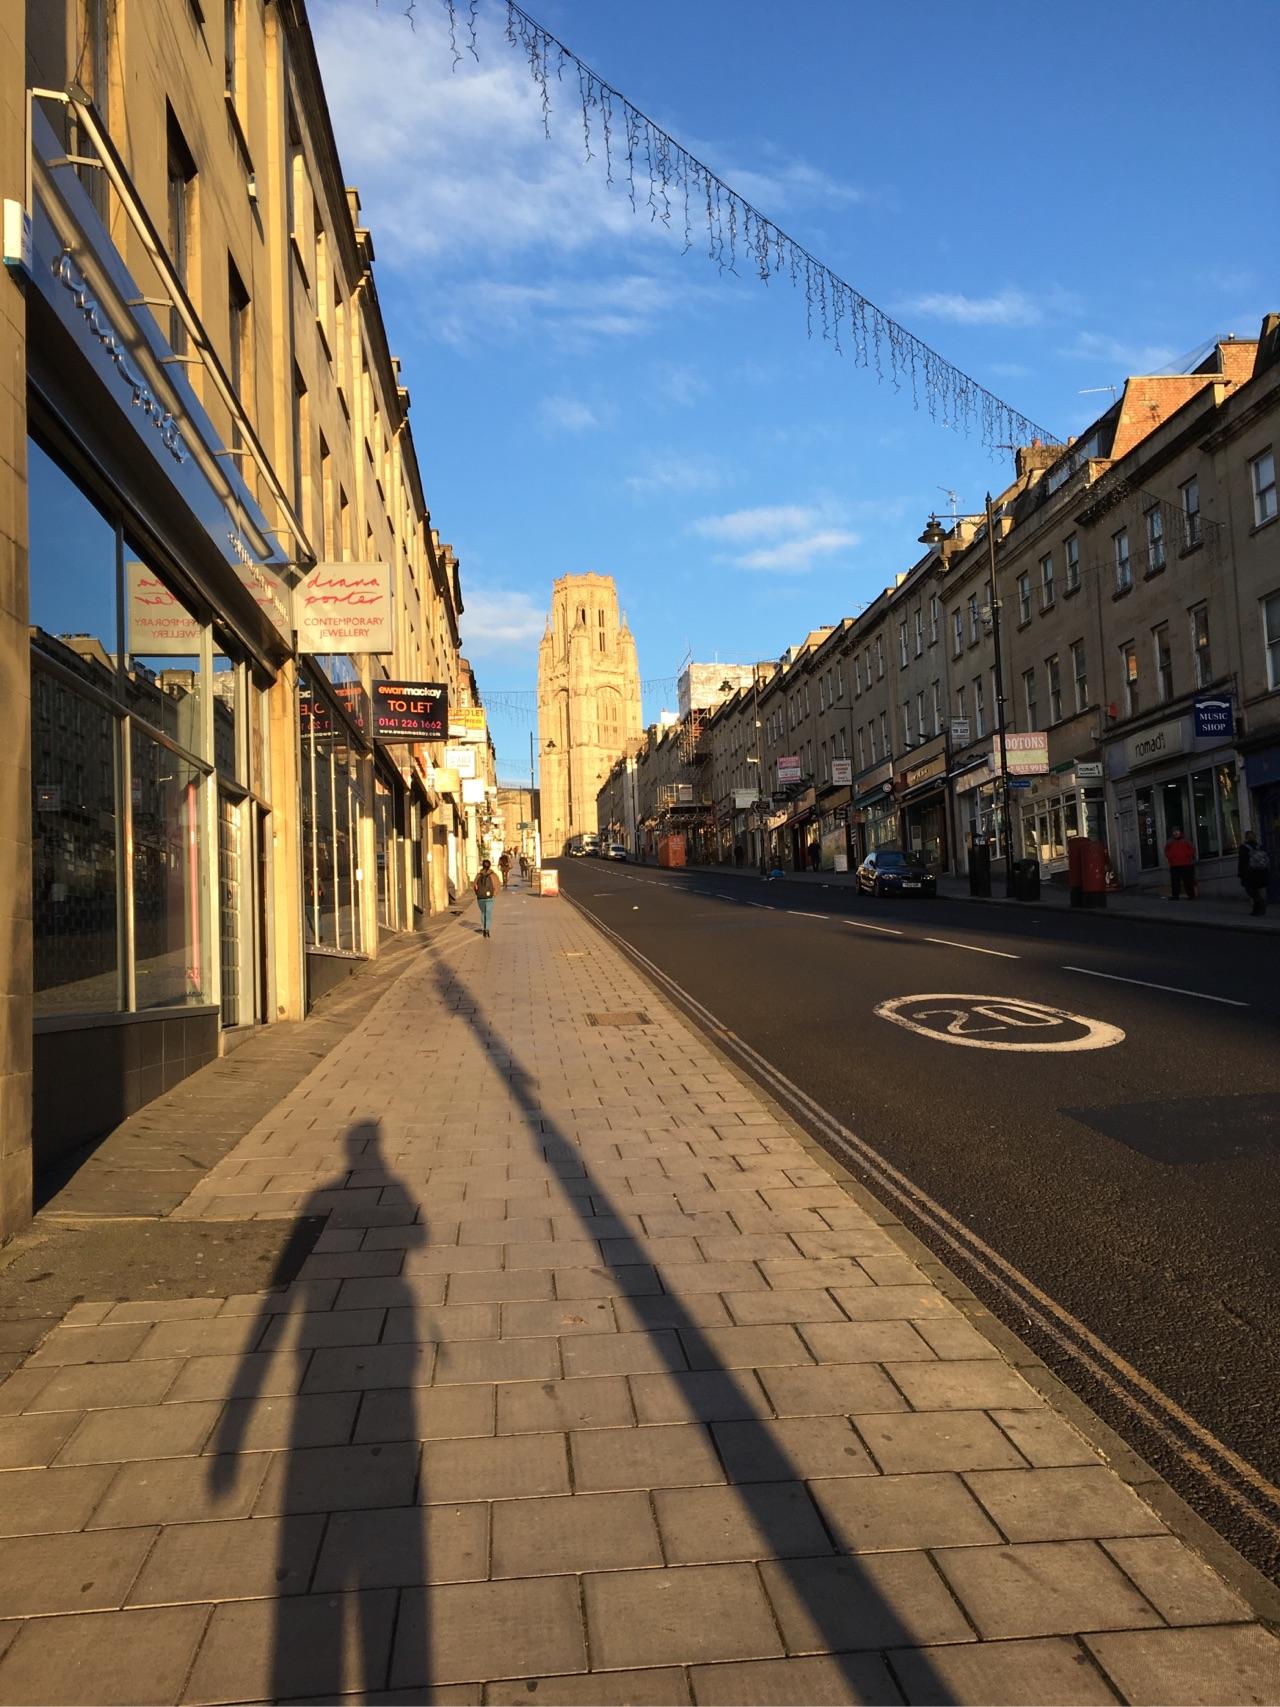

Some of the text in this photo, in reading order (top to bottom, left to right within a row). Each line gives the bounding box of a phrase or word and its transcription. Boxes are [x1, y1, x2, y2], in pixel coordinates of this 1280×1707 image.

[307, 572, 380, 589] diana
[305, 591, 383, 608] porter
[304, 616, 384, 626] CONTEMPORARY
[320, 628, 370, 639] JEWELLERY
[378, 686, 442, 699] ewanmackay
[387, 700, 433, 713] TO LET
[1199, 712, 1228, 721] MUSIC
[378, 717, 442, 729] 0141 226 1662
[1202, 723, 1226, 732] SHOP
[912, 1004, 1064, 1034] 20
